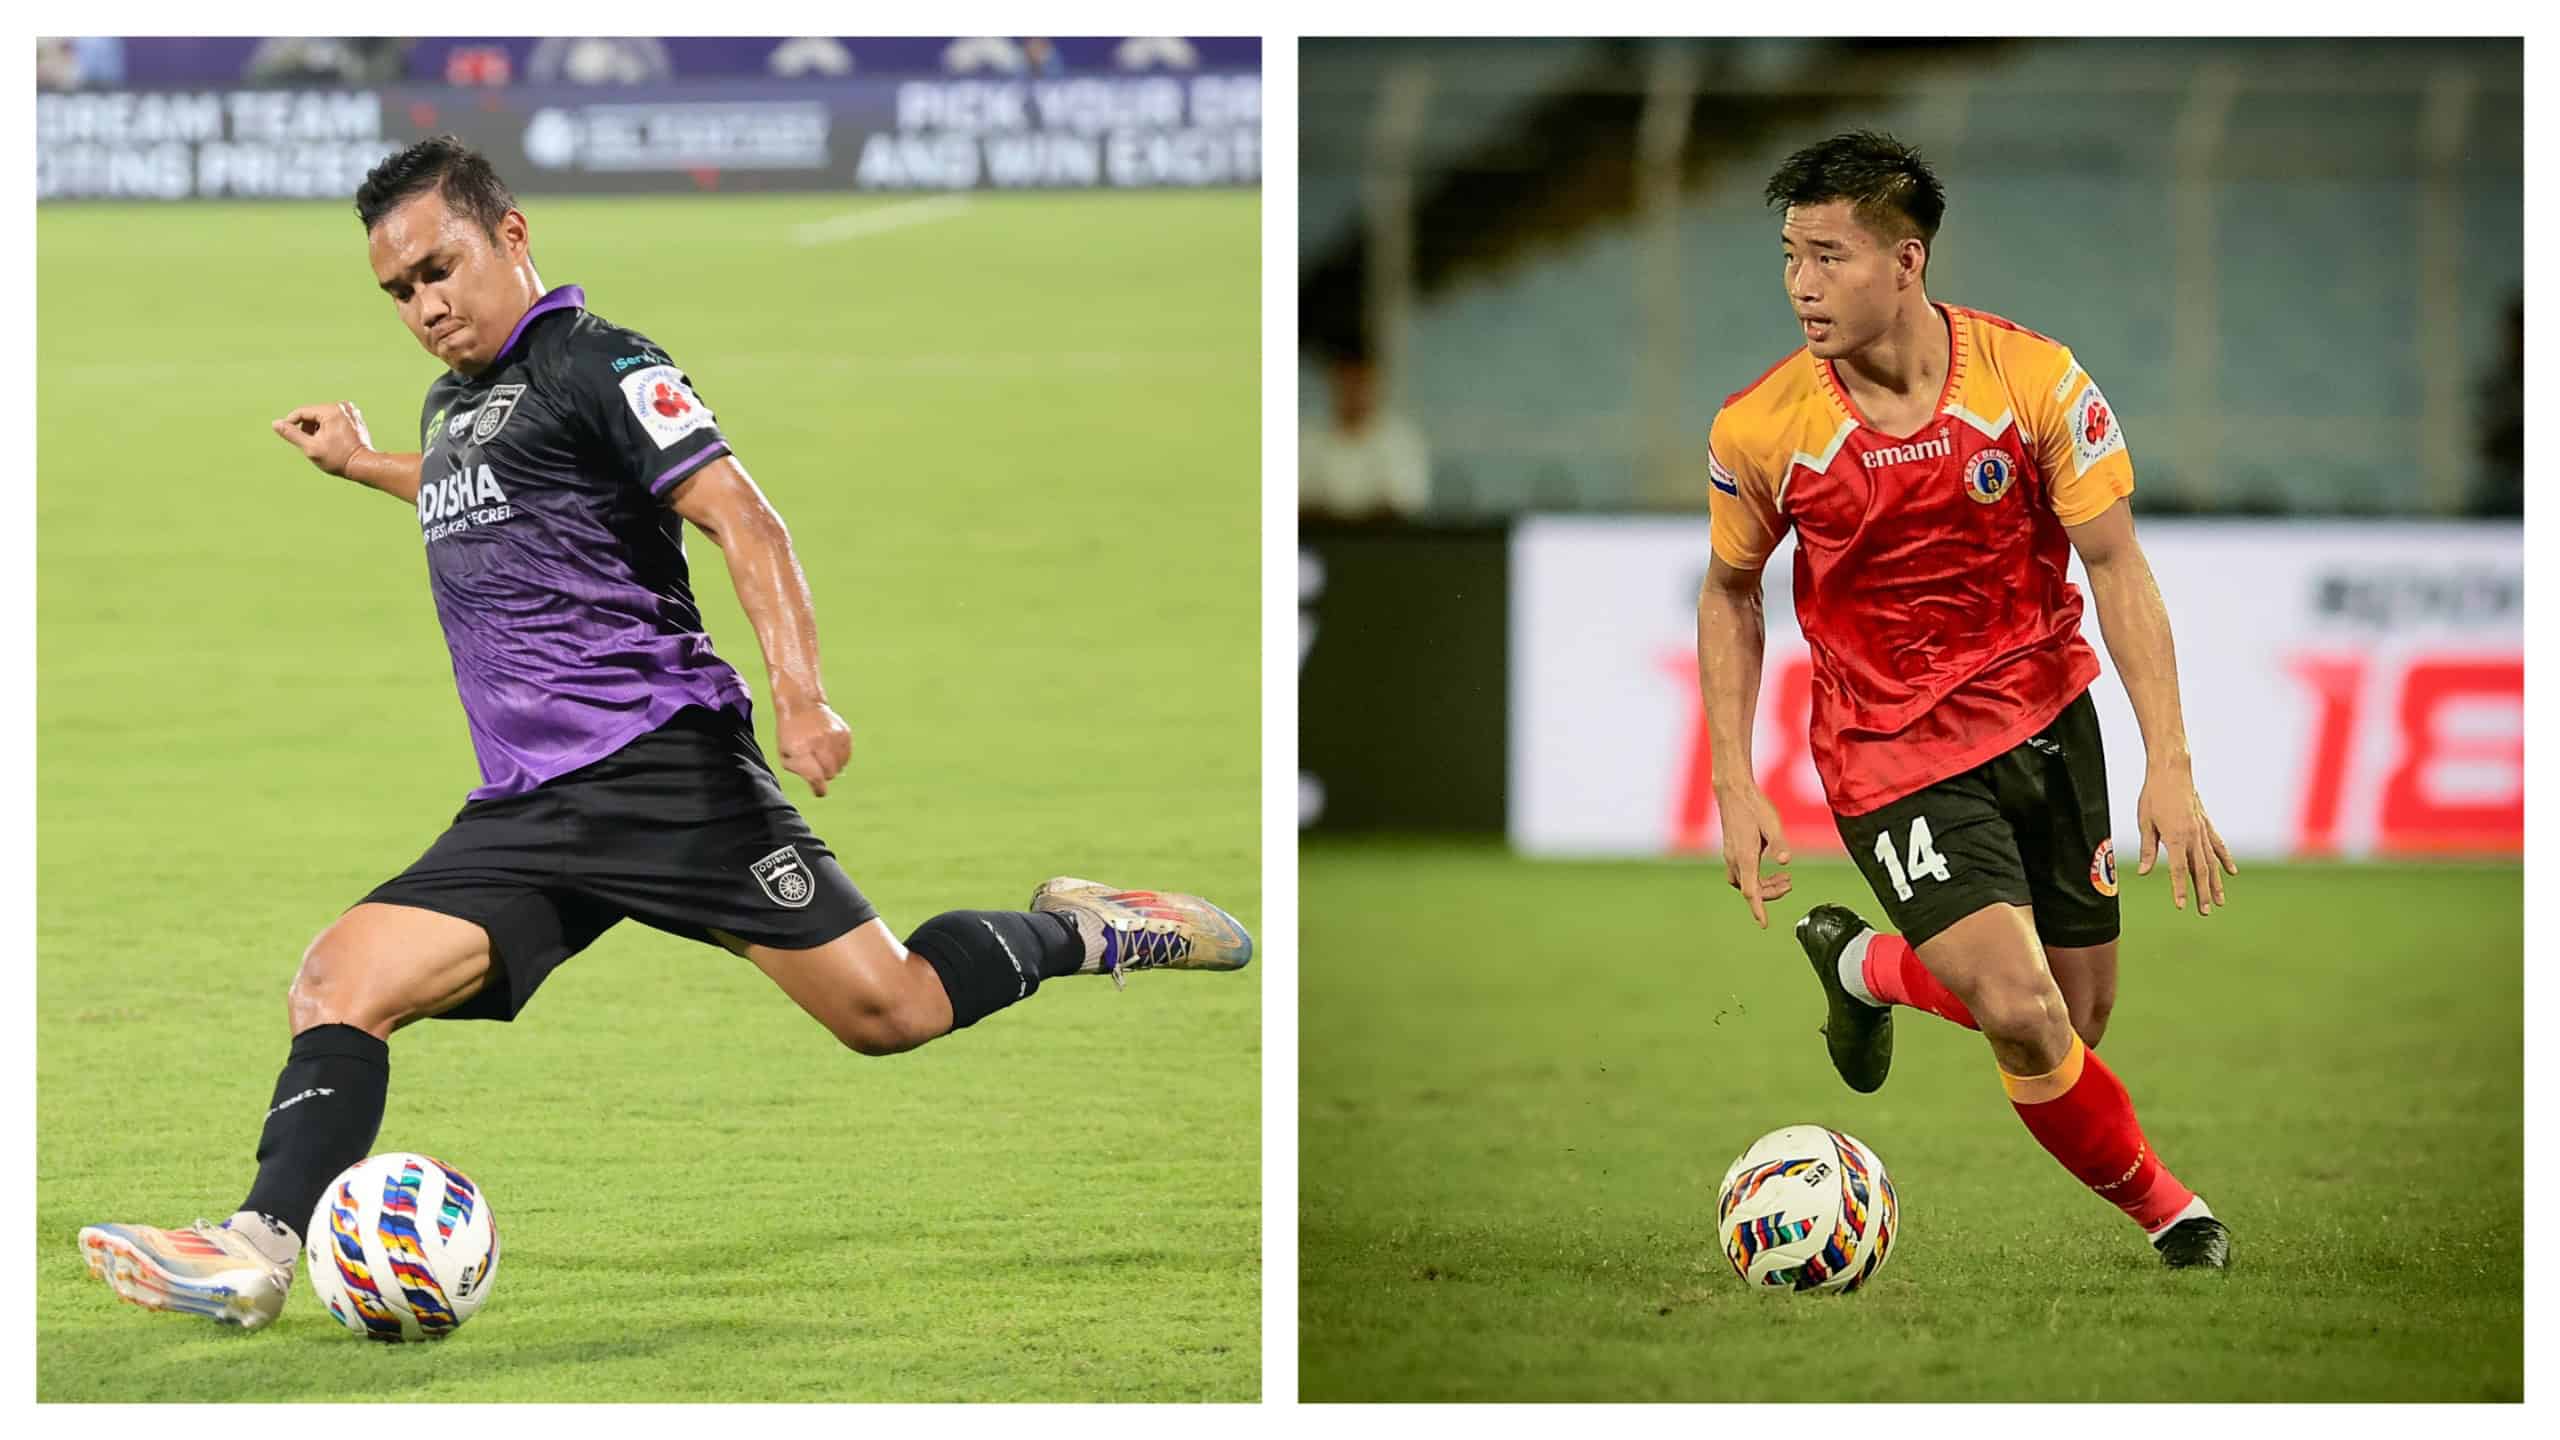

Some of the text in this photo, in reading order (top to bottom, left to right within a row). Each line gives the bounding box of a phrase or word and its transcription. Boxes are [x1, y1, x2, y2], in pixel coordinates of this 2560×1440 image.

[1862, 427, 1951, 469] emami
[759, 851, 794, 873] ODISHA
[1873, 816, 1950, 902] 14
